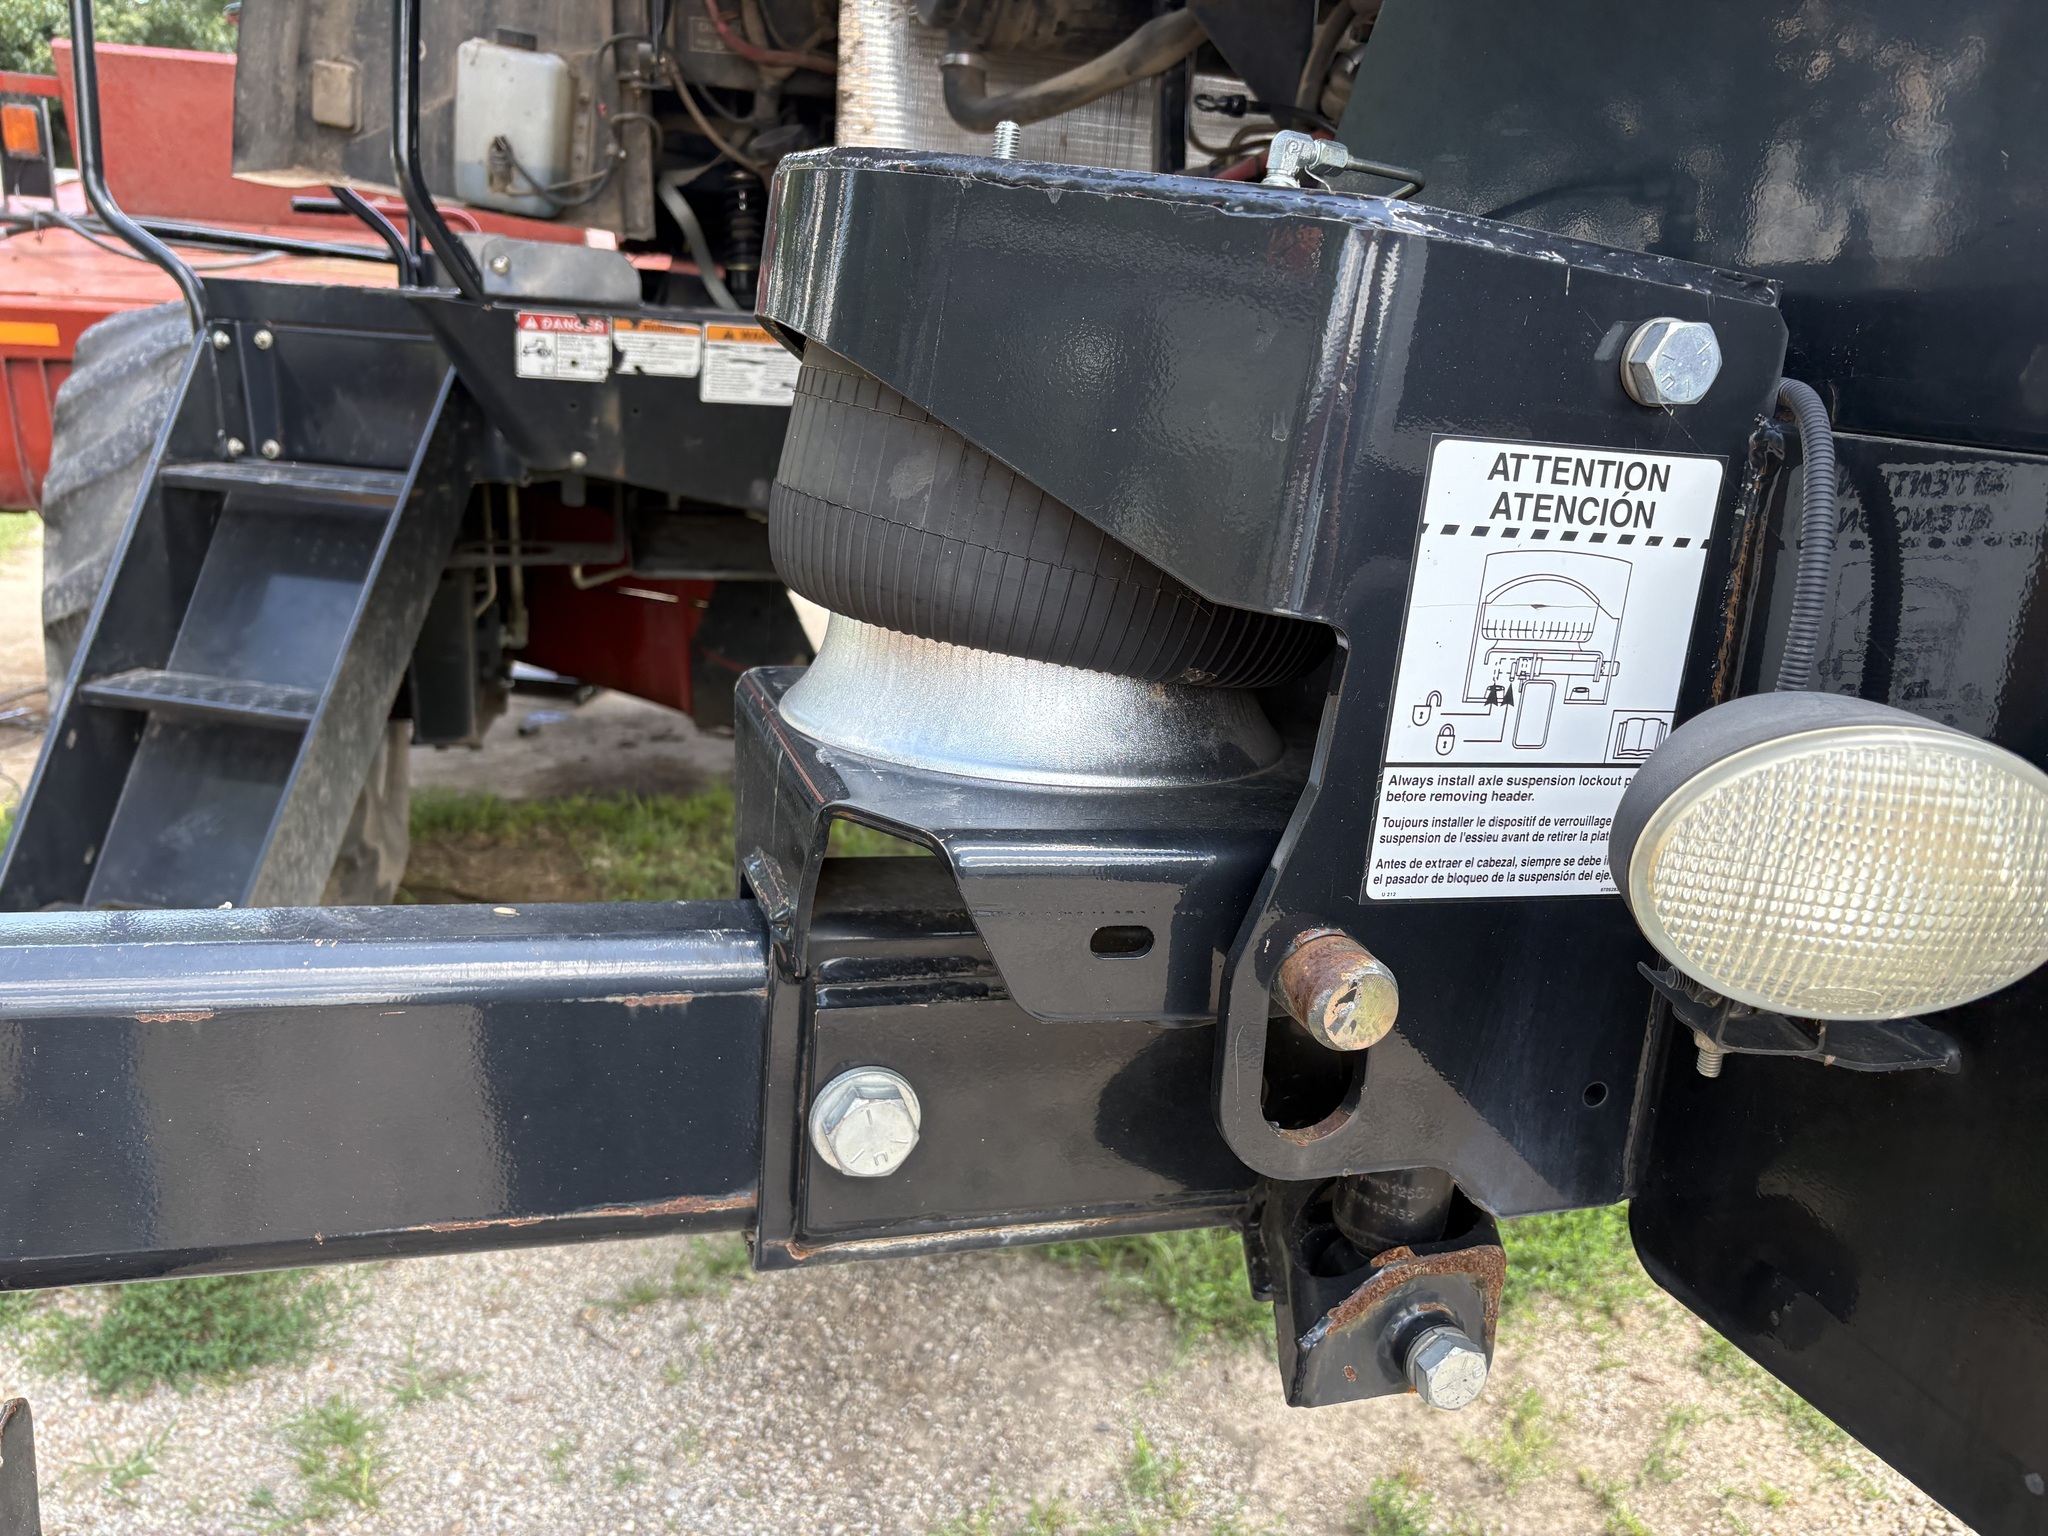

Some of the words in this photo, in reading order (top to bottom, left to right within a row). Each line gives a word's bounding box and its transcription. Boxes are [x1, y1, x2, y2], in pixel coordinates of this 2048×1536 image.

[1486, 452, 1671, 492] ATTENTION
[1489, 491, 1656, 529] ATENCIÓN
[1388, 774, 1434, 789] Always
[1437, 774, 1475, 786] install
[1478, 774, 1503, 786] axle
[1506, 774, 1576, 789] suspension
[1578, 774, 1622, 786] lockout
[1386, 790, 1427, 802] before
[1429, 790, 1488, 804] removing
[1491, 790, 1535, 802] header.
[1383, 816, 1429, 831] Toujours
[1431, 816, 1474, 828] installer
[1476, 816, 1486, 828] le
[1488, 815, 1537, 830] dispositif
[1538, 815, 1551, 827] de
[1553, 815, 1612, 829] verrouillage
[1379, 832, 1441, 847] suspension
[1443, 832, 1457, 843] de
[1459, 831, 1499, 843] l'essieu
[1501, 831, 1530, 843] avant
[1531, 830, 1545, 842] de
[1546, 830, 1577, 842] retirer
[1579, 830, 1588, 842] la
[1590, 830, 1609, 844] plat
[1375, 858, 1407, 870] Antes
[1409, 858, 1423, 869] de
[1425, 858, 1463, 869] extraer
[1464, 857, 1475, 869] el
[1476, 856, 1518, 869] cabezal,
[1520, 856, 1561, 870] siempre
[1563, 857, 1575, 867] se
[1577, 855, 1601, 866] debe
[1373, 873, 1383, 885] el
[1385, 873, 1429, 887] pasador
[1431, 872, 1445, 884] de
[1446, 872, 1489, 886] bloqueo
[1491, 871, 1504, 883] de
[1506, 871, 1516, 883] la
[1518, 870, 1575, 884] suspensión
[1577, 870, 1593, 881] del
[1595, 870, 1612, 883] eje.
